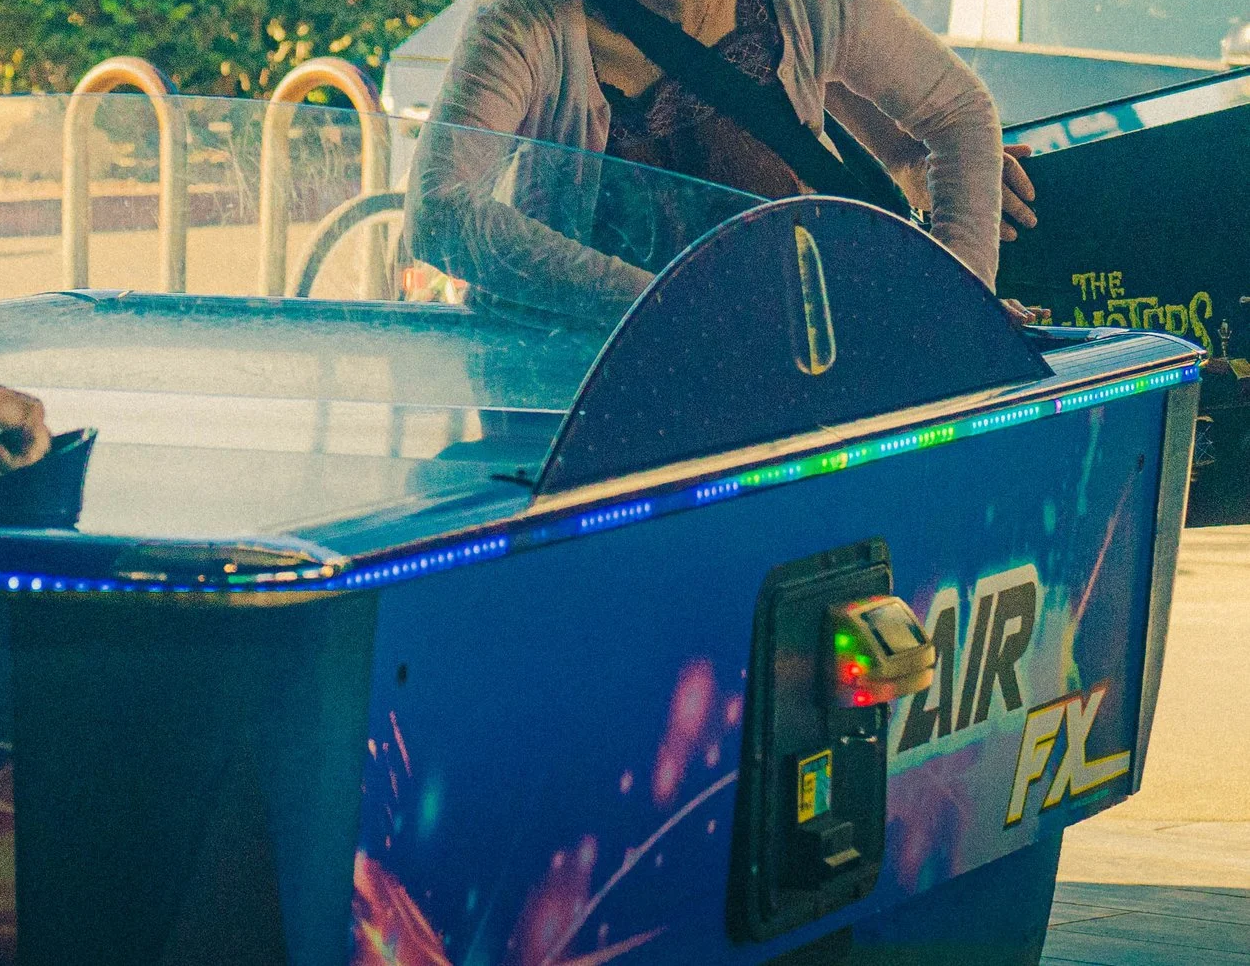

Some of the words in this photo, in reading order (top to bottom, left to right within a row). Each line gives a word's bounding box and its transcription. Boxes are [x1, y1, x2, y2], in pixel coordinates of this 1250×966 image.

[1071, 270, 1125, 301] THE
[892, 575, 1040, 756] AIR
[1005, 678, 1131, 828] FX
